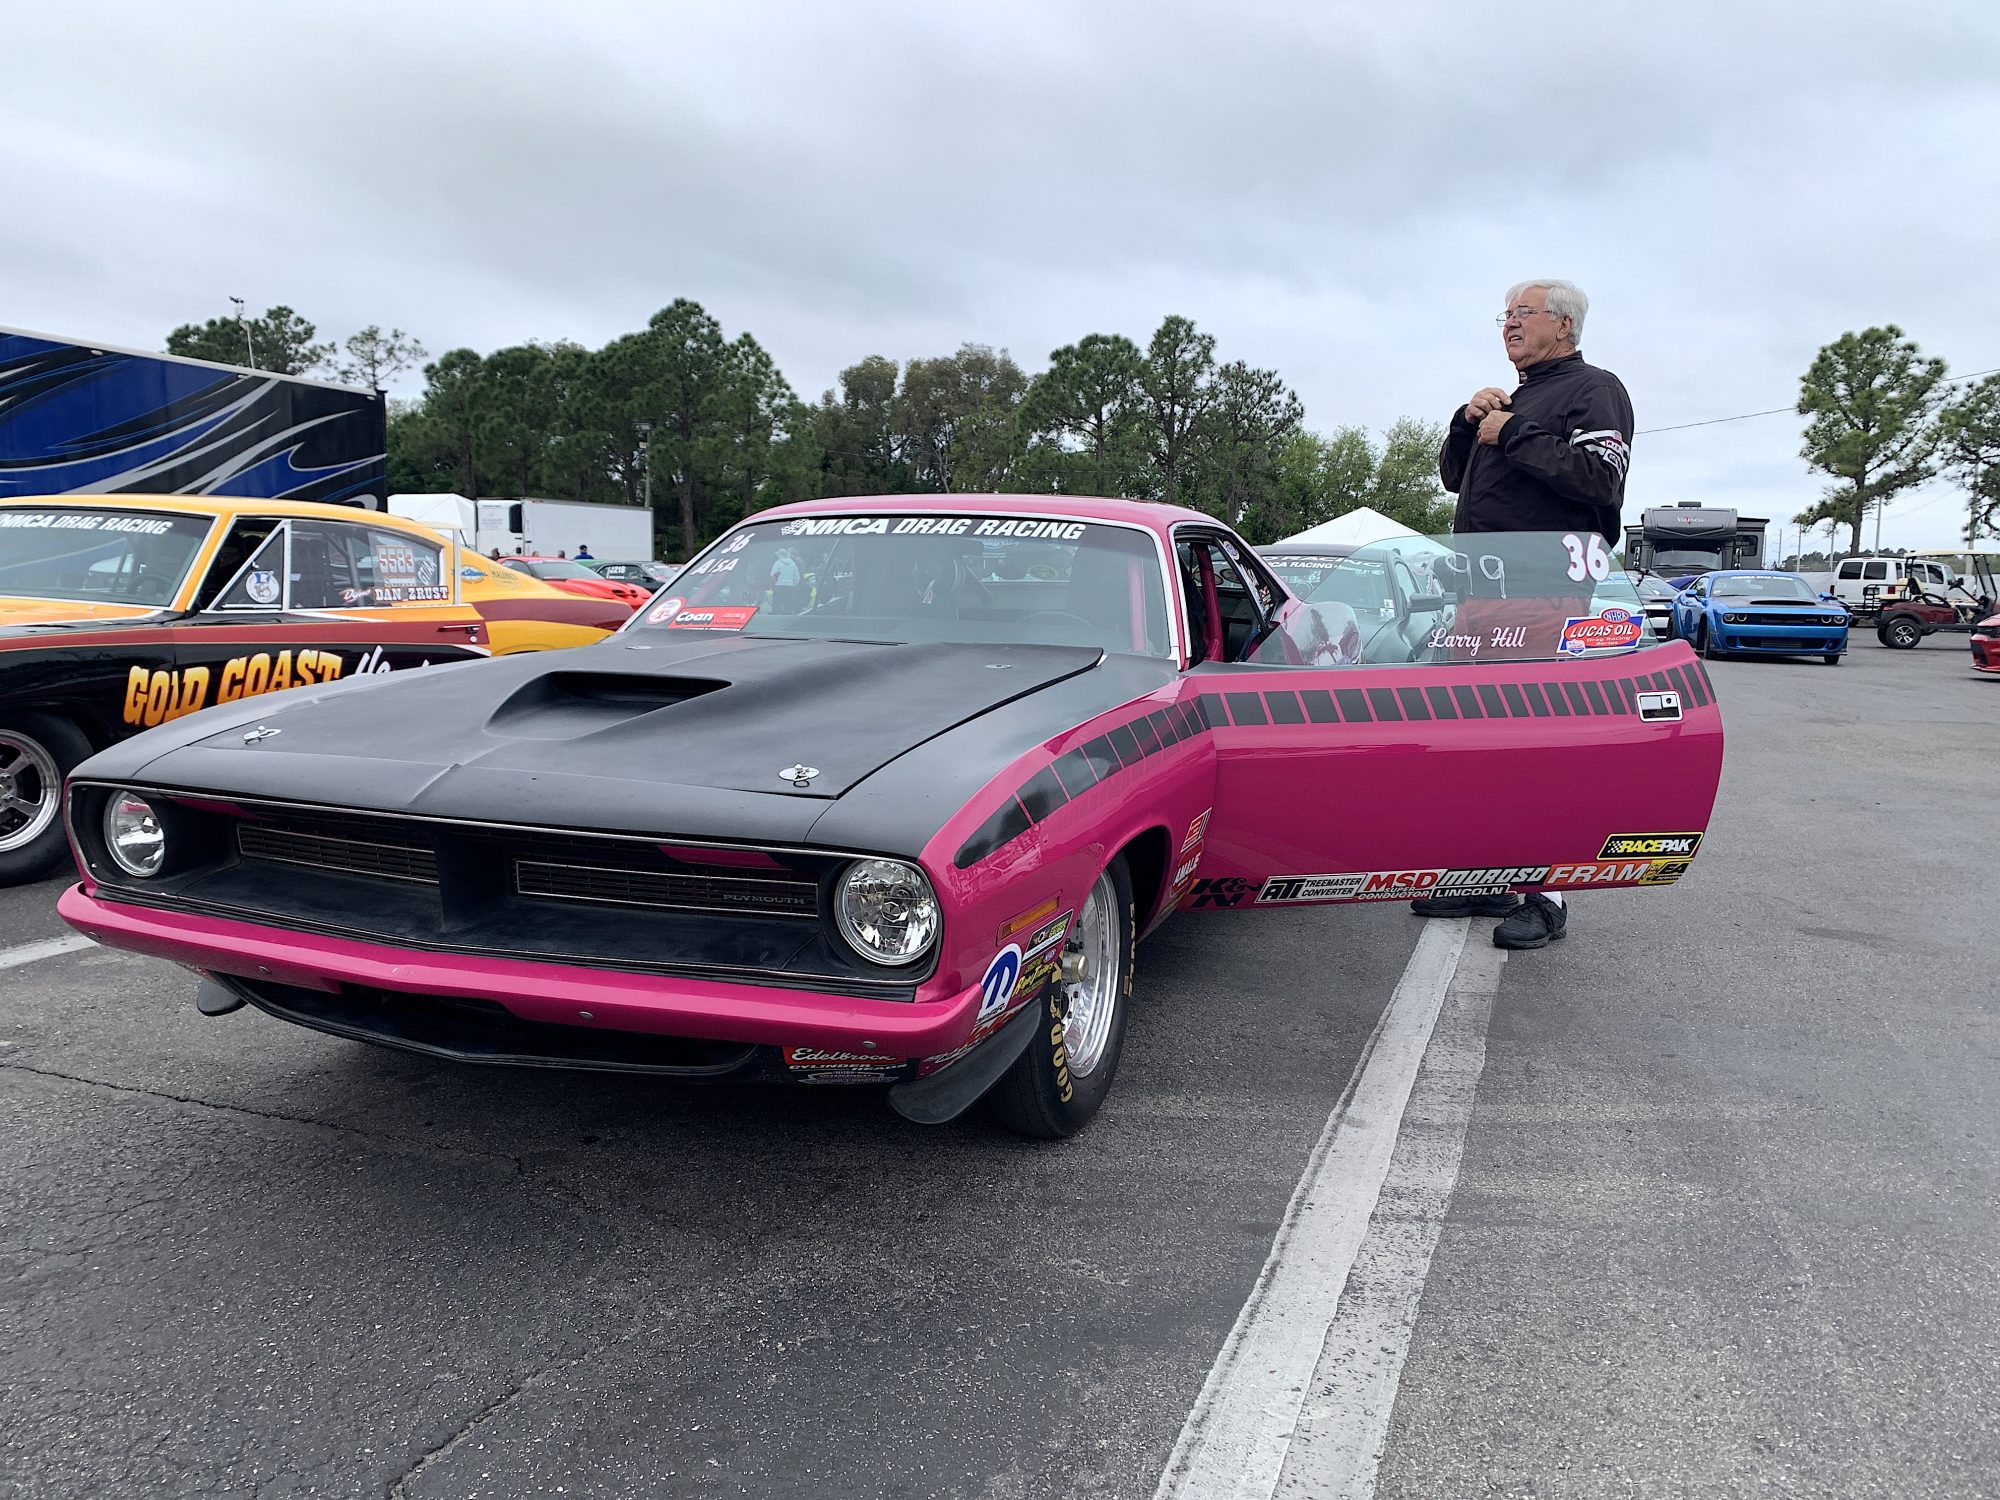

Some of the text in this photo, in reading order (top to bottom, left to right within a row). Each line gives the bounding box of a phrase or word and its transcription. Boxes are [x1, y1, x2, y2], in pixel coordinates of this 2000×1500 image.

[50, 516, 103, 529] DRAG
[99, 517, 173, 535] RACING
[795, 518, 1087, 540] NMCA DRAG RACING
[721, 533, 755, 554] 36
[1561, 533, 1610, 582] 36
[690, 558, 739, 575] A/SA
[375, 588, 401, 601] DAN
[407, 586, 449, 601] ZRUST
[675, 611, 714, 625] Coan
[1604, 611, 1629, 623] NHRA
[1570, 624, 1634, 638] LUCAS OIL
[1427, 626, 1527, 657] Larry Hill
[123, 665, 209, 728] GOLD
[217, 649, 342, 705] COAST
[1620, 838, 1694, 853] RACEPAK
[1438, 867, 1551, 885] MOROSO
[1547, 863, 1650, 884] FRAM
[1304, 877, 1362, 888] TREEMASTER
[1364, 872, 1440, 892] MSD
[723, 894, 805, 905] PLYMOUTH
[1301, 888, 1353, 897] CONVERTER
[1357, 890, 1431, 900] CONDUCTOR
[1435, 886, 1504, 898] LINCOLN
